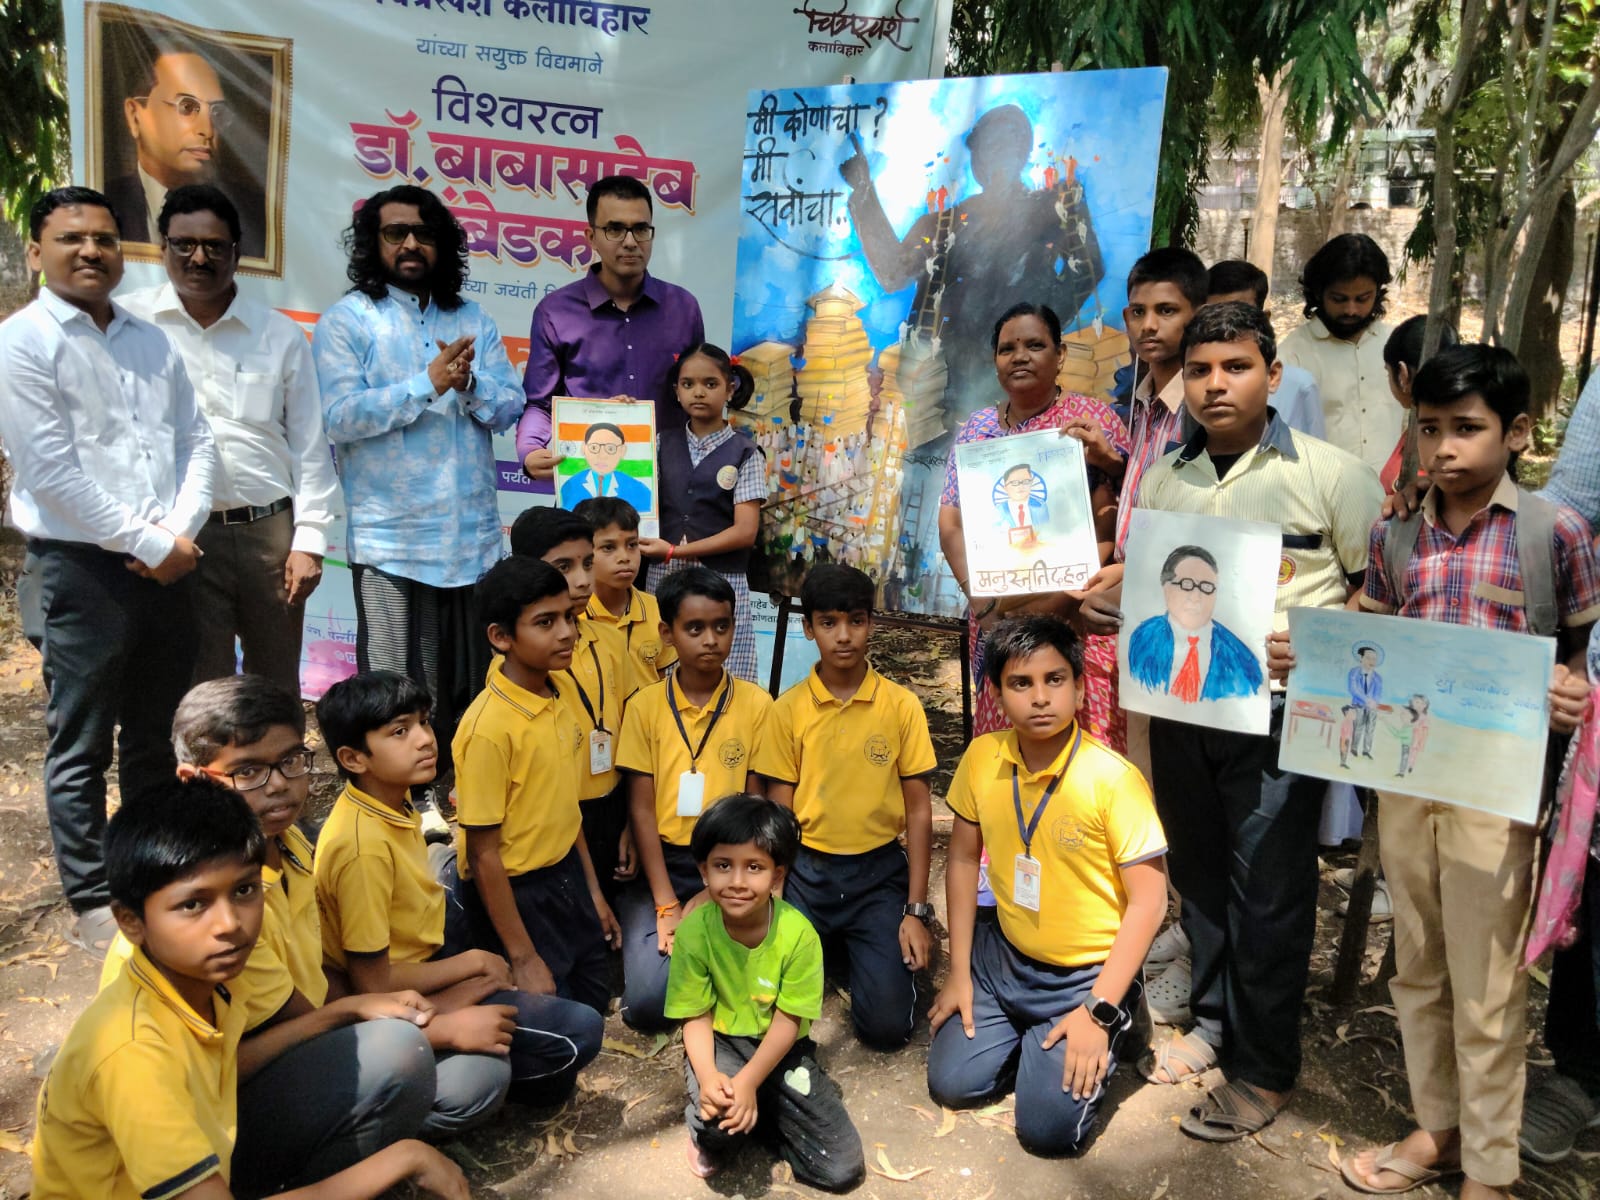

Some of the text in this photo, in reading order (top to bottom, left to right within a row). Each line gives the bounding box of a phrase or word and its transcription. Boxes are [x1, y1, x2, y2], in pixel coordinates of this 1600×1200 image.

[415, 33, 604, 75] यांच्या सयुक्त विद्यमाने
[807, 40, 865, 57] कलाविहार
[432, 74, 603, 139] विश्वरत्न
[494, 279, 538, 300] जयंती
